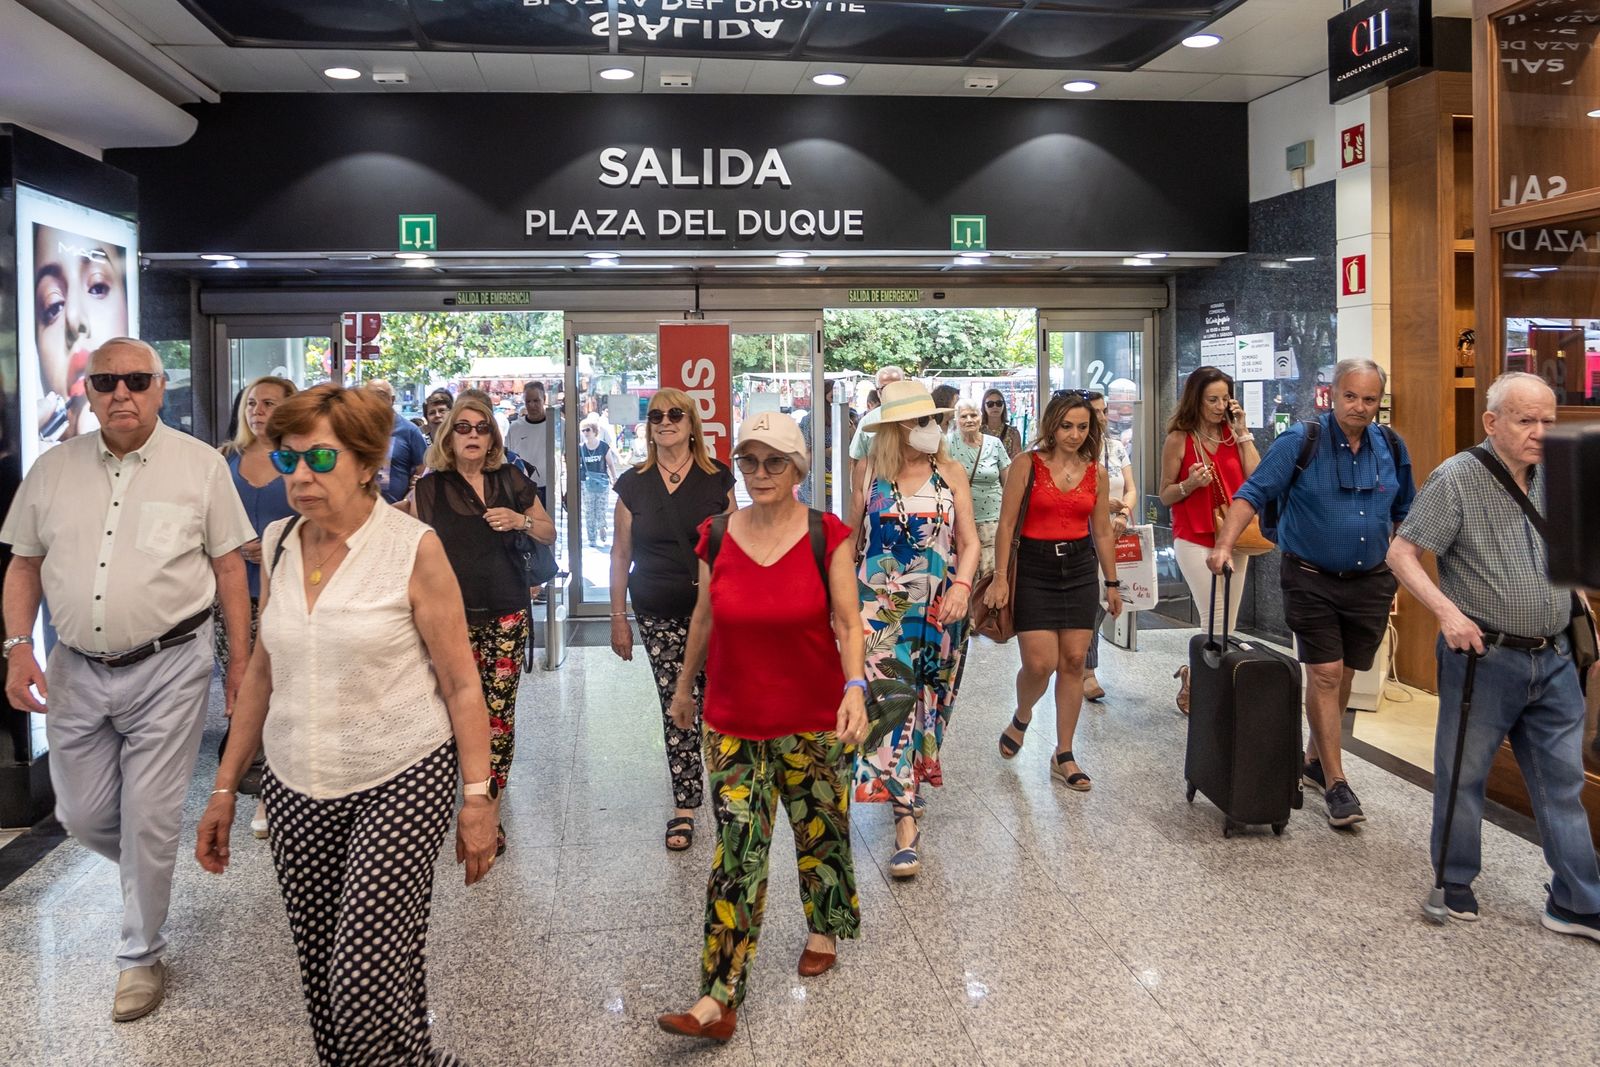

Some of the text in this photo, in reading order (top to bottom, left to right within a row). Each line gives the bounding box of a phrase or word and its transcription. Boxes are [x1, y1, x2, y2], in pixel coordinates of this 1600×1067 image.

[1351, 8, 1389, 57] CH
[1337, 46, 1409, 82] CAROLINA HERRERA
[598, 147, 792, 186] SALIDA
[525, 209, 864, 237] PLAZA DEL DUQUE
[457, 291, 530, 305] SALIDA DE EMERGENCIA
[849, 290, 919, 303] SALIDA DE EMERGENCIA
[752, 414, 769, 431] A
